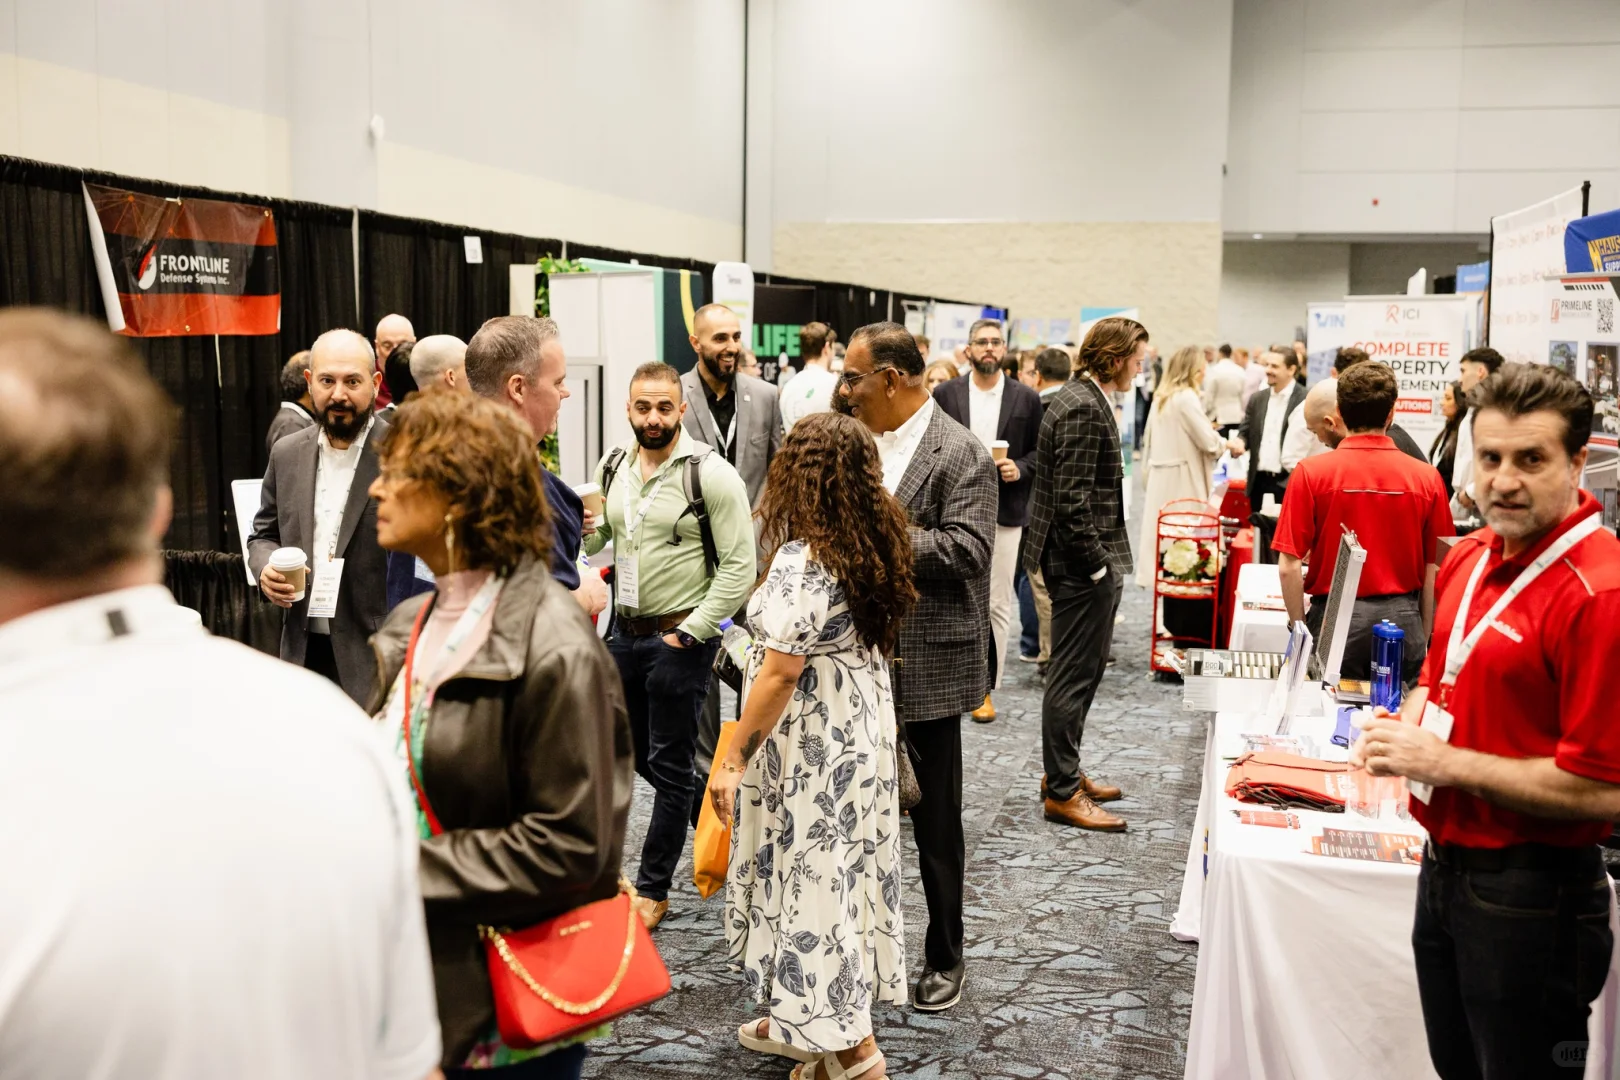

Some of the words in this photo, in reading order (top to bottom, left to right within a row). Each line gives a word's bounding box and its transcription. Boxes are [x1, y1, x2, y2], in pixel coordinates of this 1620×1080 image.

[160, 255, 230, 274] FRONTLINE
[160, 273, 193, 283] Defense
[1560, 300, 1592, 311] PRIMELINE
[1402, 308, 1420, 320] ICI
[751, 323, 801, 357] LIFE
